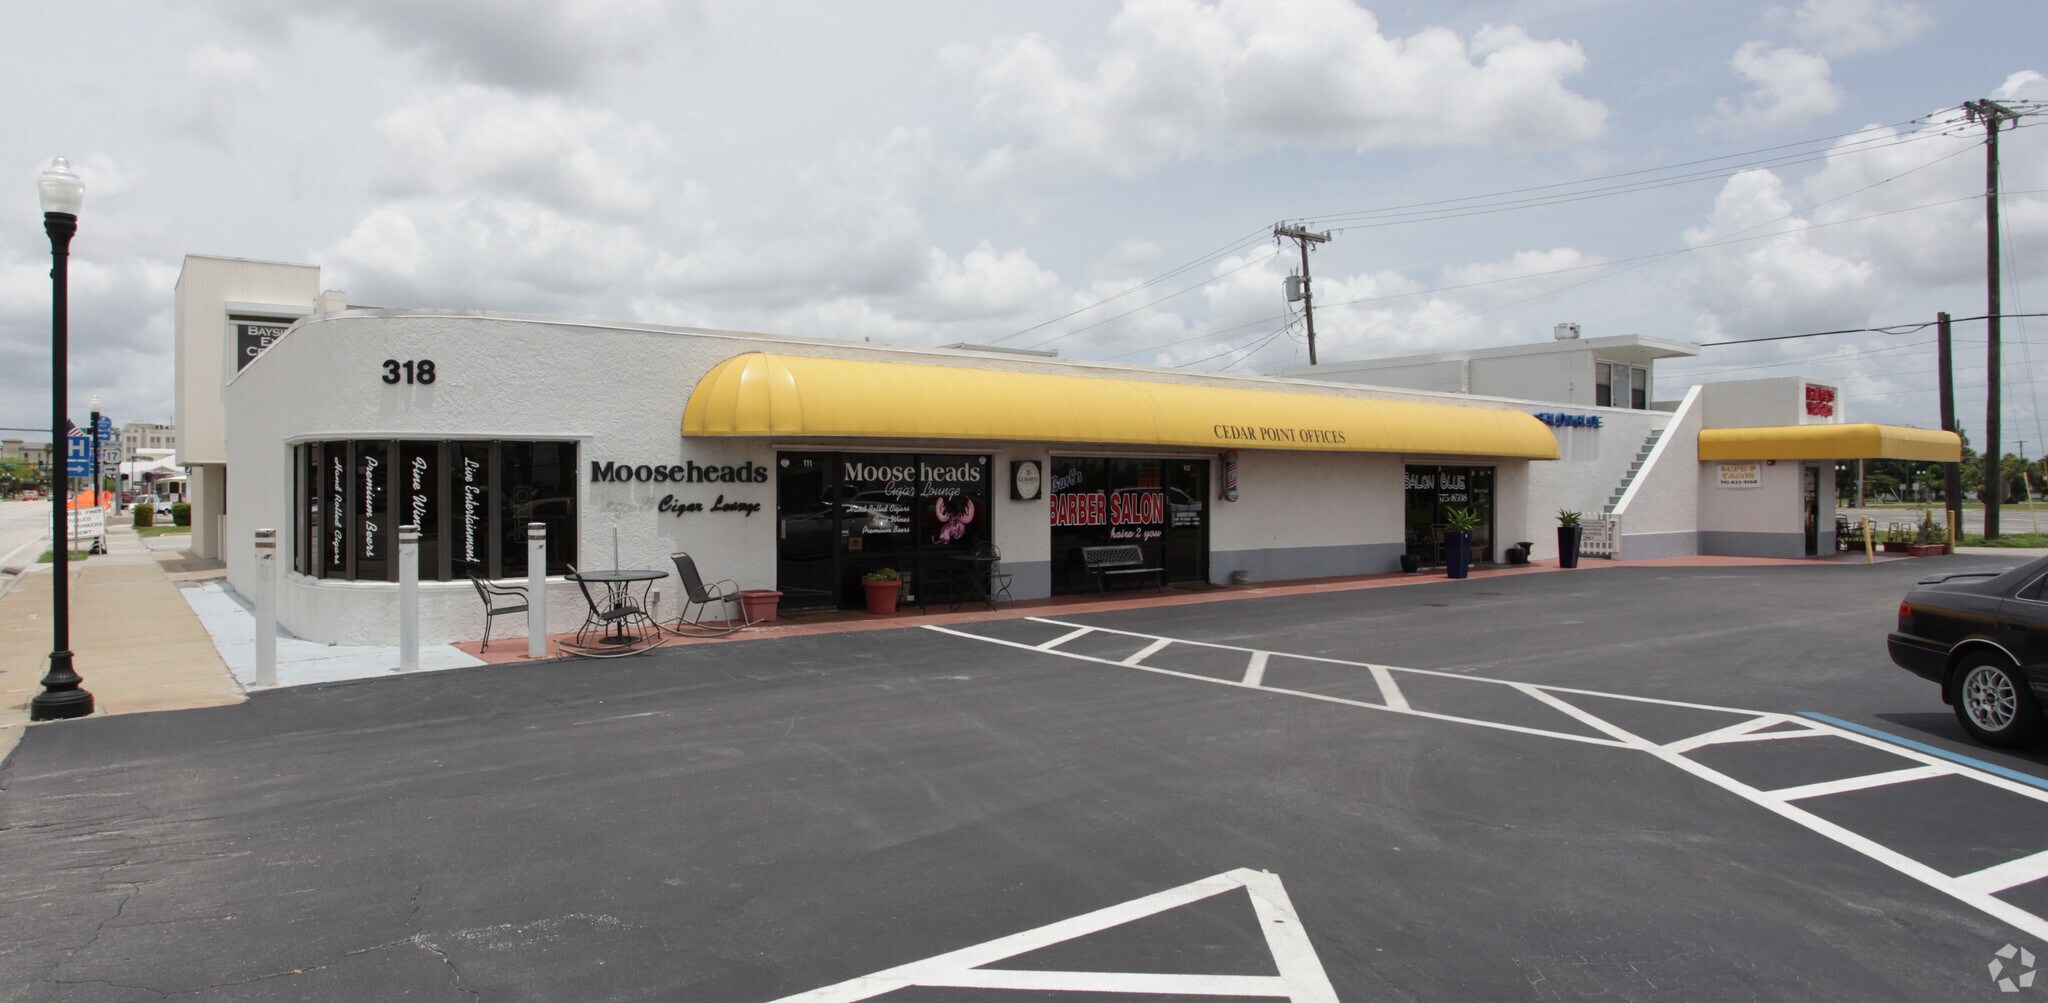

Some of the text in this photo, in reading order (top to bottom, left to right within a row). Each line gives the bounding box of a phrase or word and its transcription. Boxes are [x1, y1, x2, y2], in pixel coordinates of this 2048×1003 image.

[382, 359, 436, 385] 318
[1213, 424, 1346, 444] CEDAR POINT OFFICES
[68, 439, 86, 457] H
[107, 452, 118, 462] 17
[412, 456, 427, 490] Fine
[590, 460, 768, 483] Mooseheads
[1405, 472, 1435, 489] SALON
[884, 480, 961, 501] Cigar Lounge
[332, 456, 344, 565] Hand Rolled Cigars
[365, 456, 378, 557] Premium Beers
[464, 457, 480, 563] Live Entertainment
[658, 494, 704, 518] Cigar
[710, 494, 761, 518] Lounge
[1050, 493, 1107, 526] BARBER
[1110, 492, 1164, 526] SALON
[1135, 527, 1143, 538] 2
[1144, 529, 1163, 542] you
